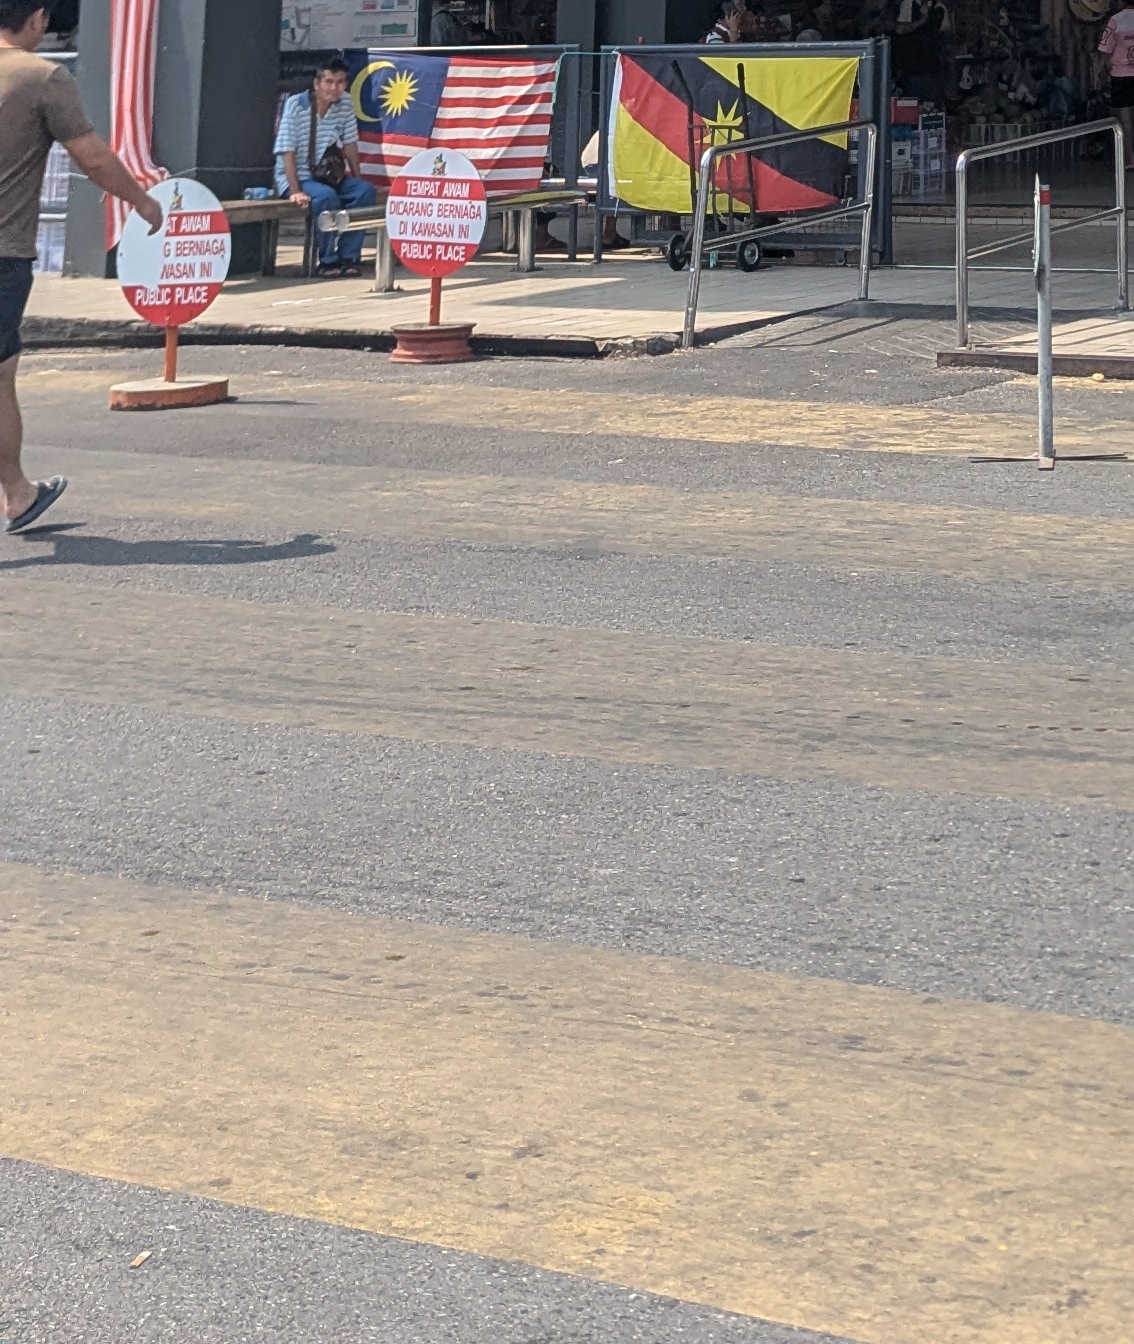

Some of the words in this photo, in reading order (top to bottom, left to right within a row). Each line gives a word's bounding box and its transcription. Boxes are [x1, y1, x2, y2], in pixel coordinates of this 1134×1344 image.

[406, 180, 441, 196] TEMPAT
[442, 183, 470, 198] AWAM
[389, 200, 434, 217] DILARANG
[437, 203, 482, 220] BERNIAGA
[180, 214, 211, 233] AWAM
[399, 221, 408, 235] DI
[411, 222, 454, 238] KAWASAN
[458, 224, 470, 239] INI
[175, 239, 226, 257] BERNIAGA
[400, 242, 432, 260] PUBLIC
[436, 244, 465, 261] PLACE
[200, 261, 212, 277] INI
[135, 287, 171, 305] PUBLIC
[174, 286, 208, 304] PLACE
